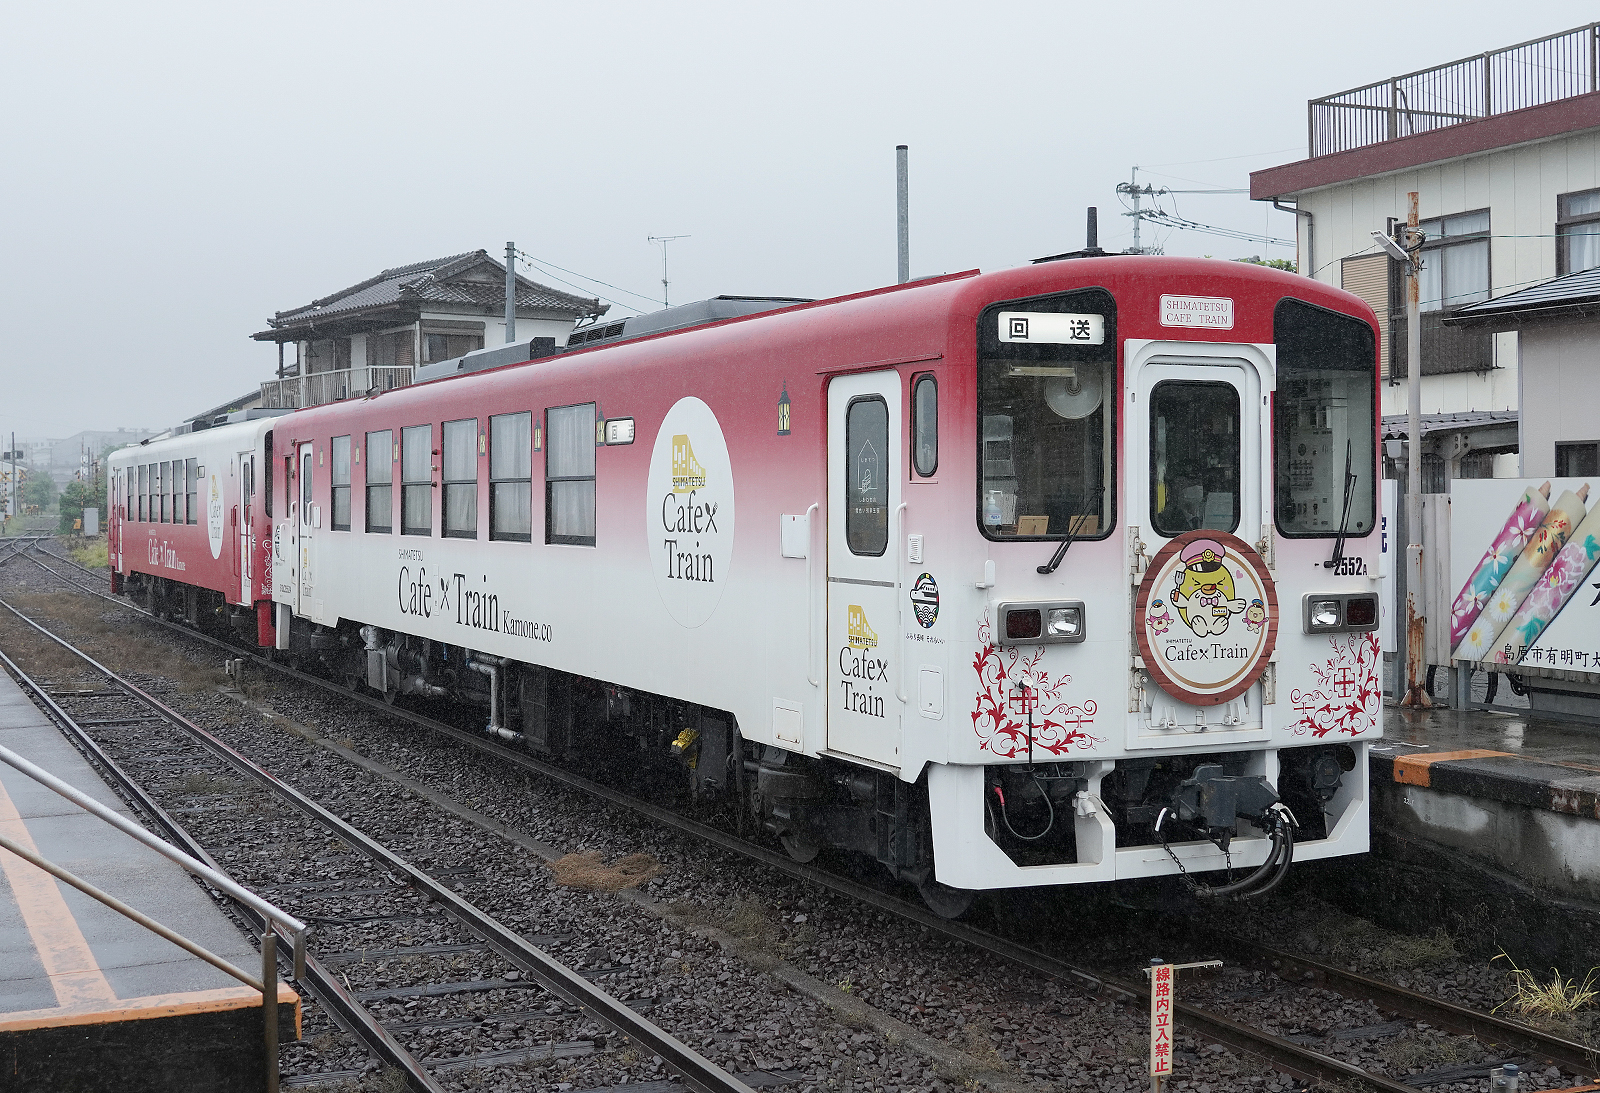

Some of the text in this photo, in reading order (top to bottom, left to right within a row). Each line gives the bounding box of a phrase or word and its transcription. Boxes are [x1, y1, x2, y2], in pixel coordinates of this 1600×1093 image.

[1166, 299, 1228, 313] SHIMATETSU
[1166, 312, 1228, 325] CAFE TRAIN
[672, 476, 706, 487] SHIMATETSU
[662, 490, 703, 533] Cafe
[398, 548, 424, 562] SHIMATETSU
[664, 538, 715, 583] Train
[399, 565, 553, 643] Cafe Train Kamone.co
[848, 635, 878, 647] SHIMATETSU
[1165, 643, 1249, 662] Cafe Train
[839, 646, 876, 681] Cafe
[841, 680, 885, 719] Train
[1154, 967, 1170, 1073] 線路内立入禁止
